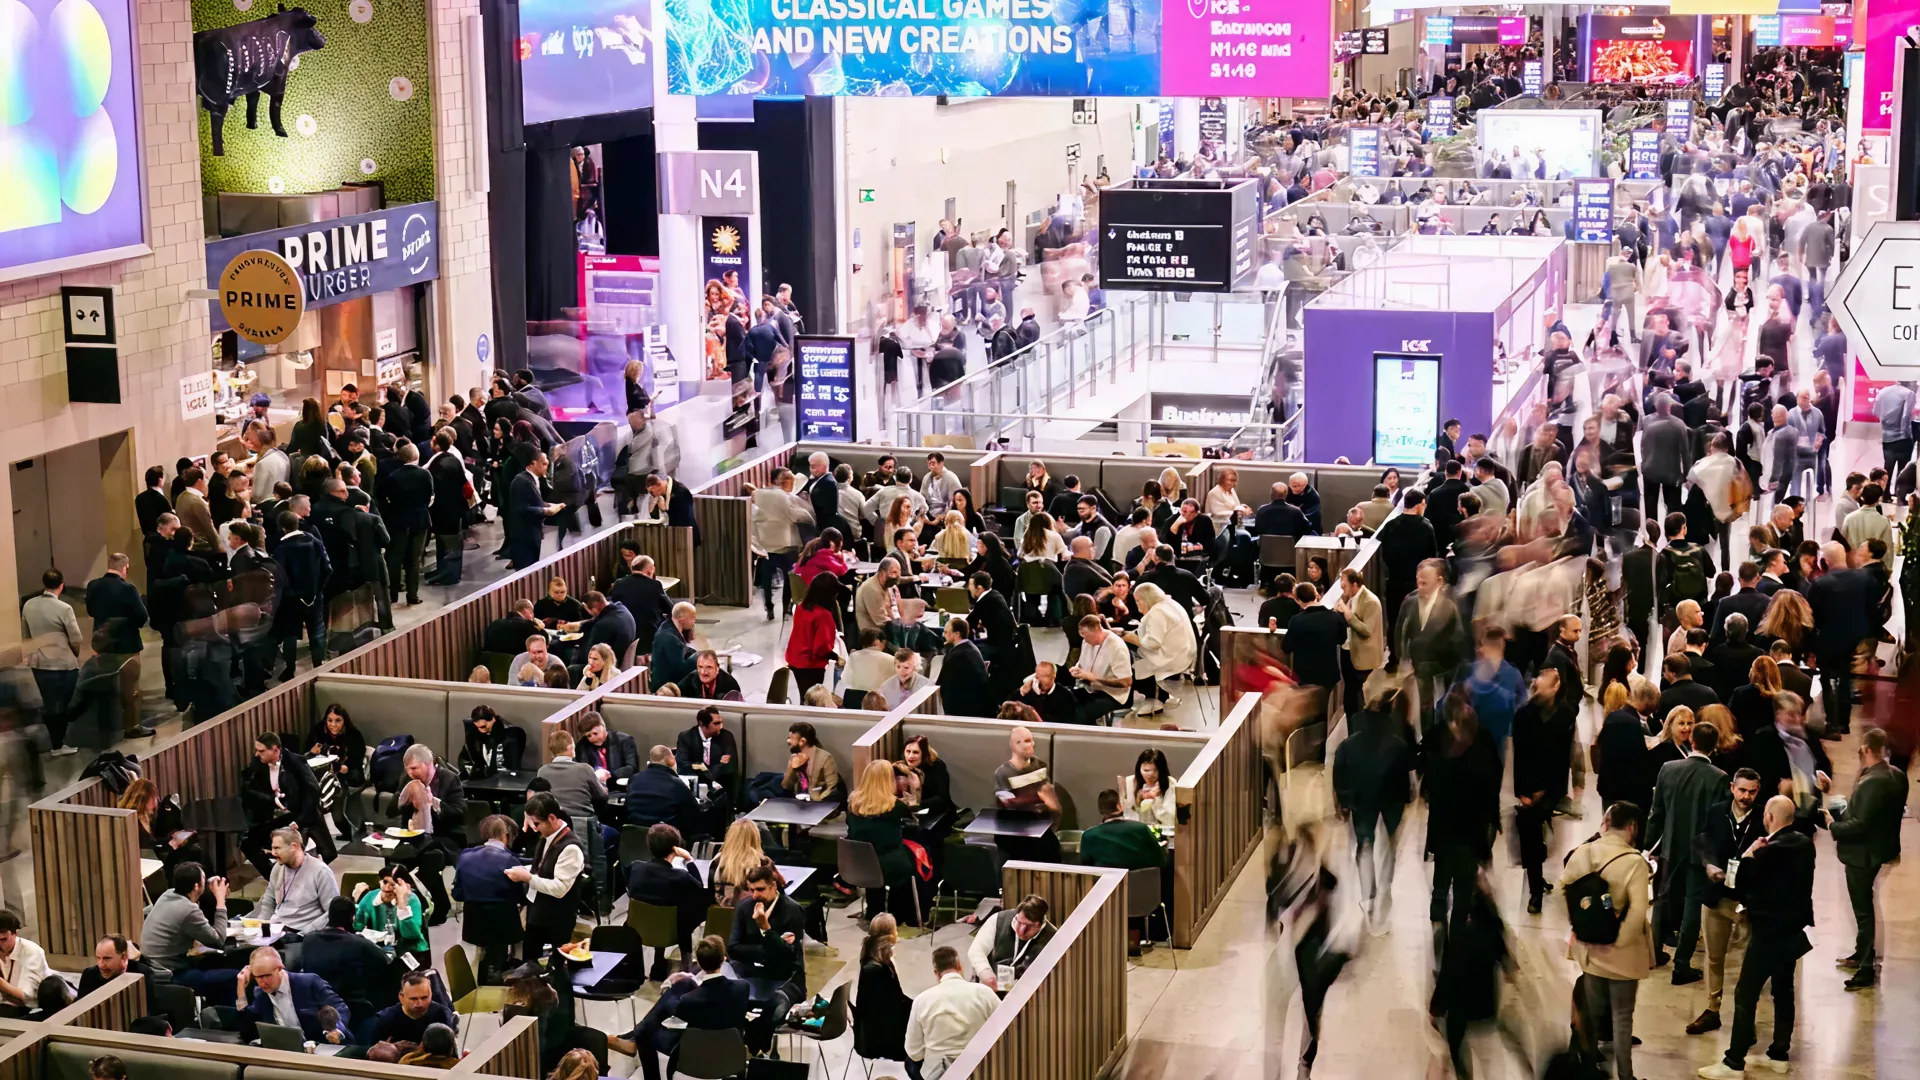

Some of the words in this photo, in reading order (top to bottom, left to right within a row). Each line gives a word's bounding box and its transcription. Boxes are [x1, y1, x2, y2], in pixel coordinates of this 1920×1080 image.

[772, 0, 935, 20] CLASSICAL
[943, 0, 1053, 20] GAMES
[752, 26, 814, 54] AND
[823, 26, 892, 54] NEW
[900, 25, 1073, 54] CREATIONS
[700, 168, 747, 199] N4
[284, 218, 388, 275] PRIME
[304, 265, 371, 301] URGER
[1892, 266, 1920, 310] E
[226, 290, 297, 310] PRIME
